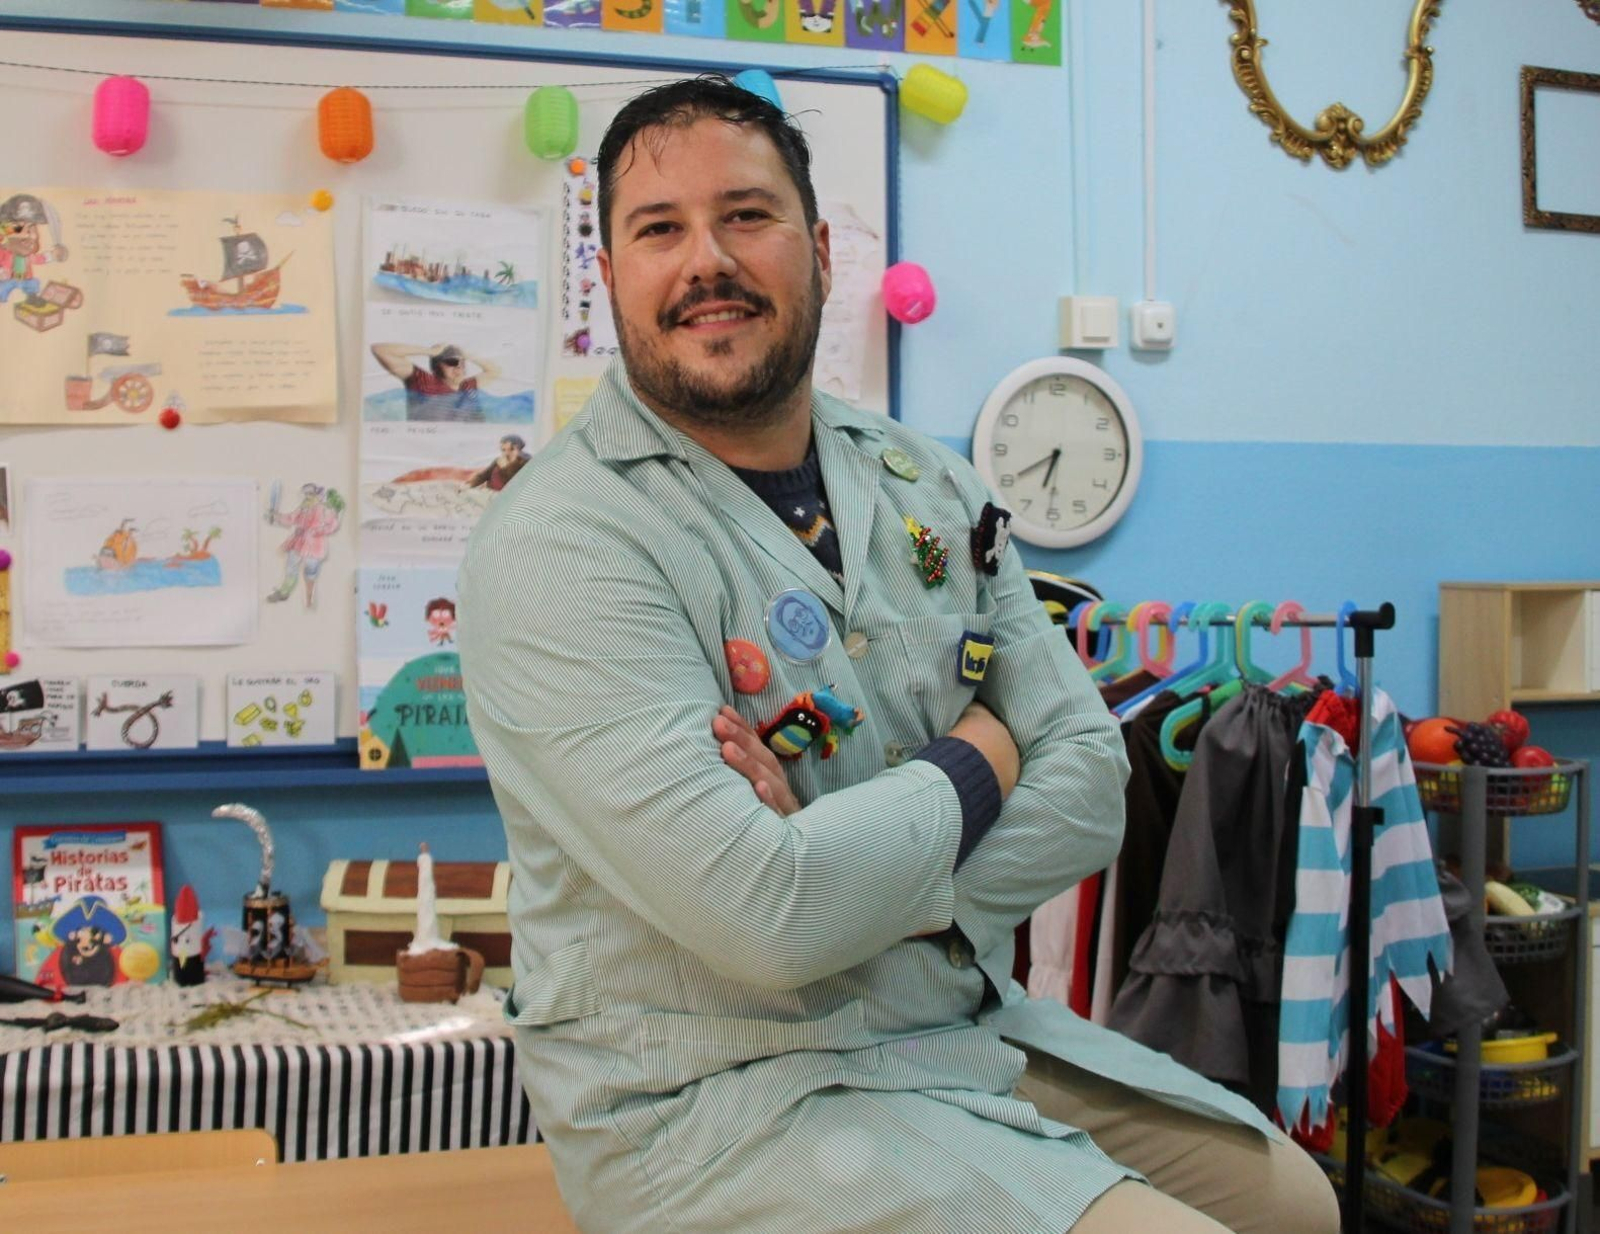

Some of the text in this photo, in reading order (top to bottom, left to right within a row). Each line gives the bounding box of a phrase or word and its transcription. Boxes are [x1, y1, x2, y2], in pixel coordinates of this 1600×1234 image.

[1048, 383, 1066, 396] 12
[1024, 393, 1035, 404] 11
[1001, 414, 1019, 427] 10
[1096, 418, 1109, 430] 2
[994, 443, 1008, 456] 9
[1104, 448, 1116, 461] 3
[1000, 474, 1014, 487] 8
[1020, 499, 1032, 511] 7
[1073, 500, 1087, 513] 5
[1046, 509, 1060, 521] 6
[394, 703, 470, 725] PIRAT
[50, 849, 129, 866] Historias
[77, 864, 92, 876] de
[54, 874, 128, 894] Piratas
